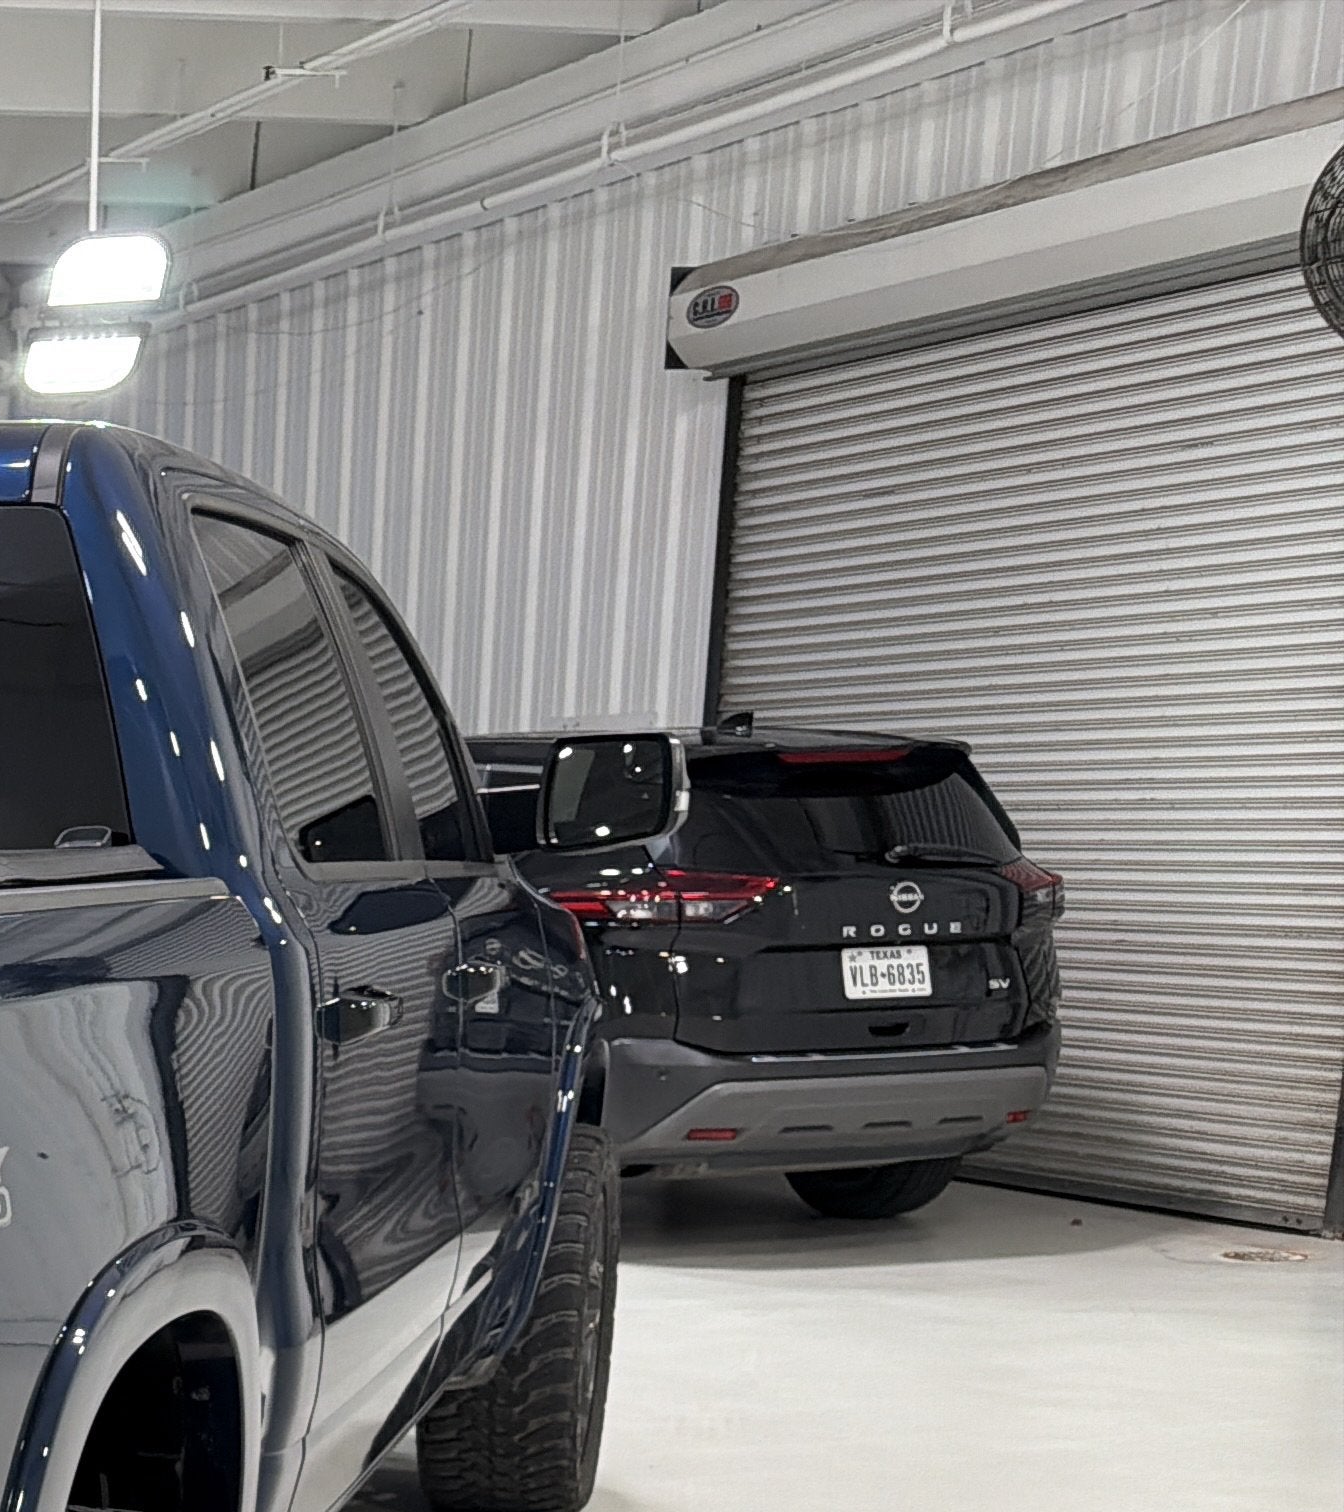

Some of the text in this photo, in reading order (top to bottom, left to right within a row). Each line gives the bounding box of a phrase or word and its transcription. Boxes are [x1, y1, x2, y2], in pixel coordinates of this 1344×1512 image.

[842, 921, 963, 938] ROGUE
[869, 949, 903, 961] TEXAS
[988, 977, 1011, 990] SV
